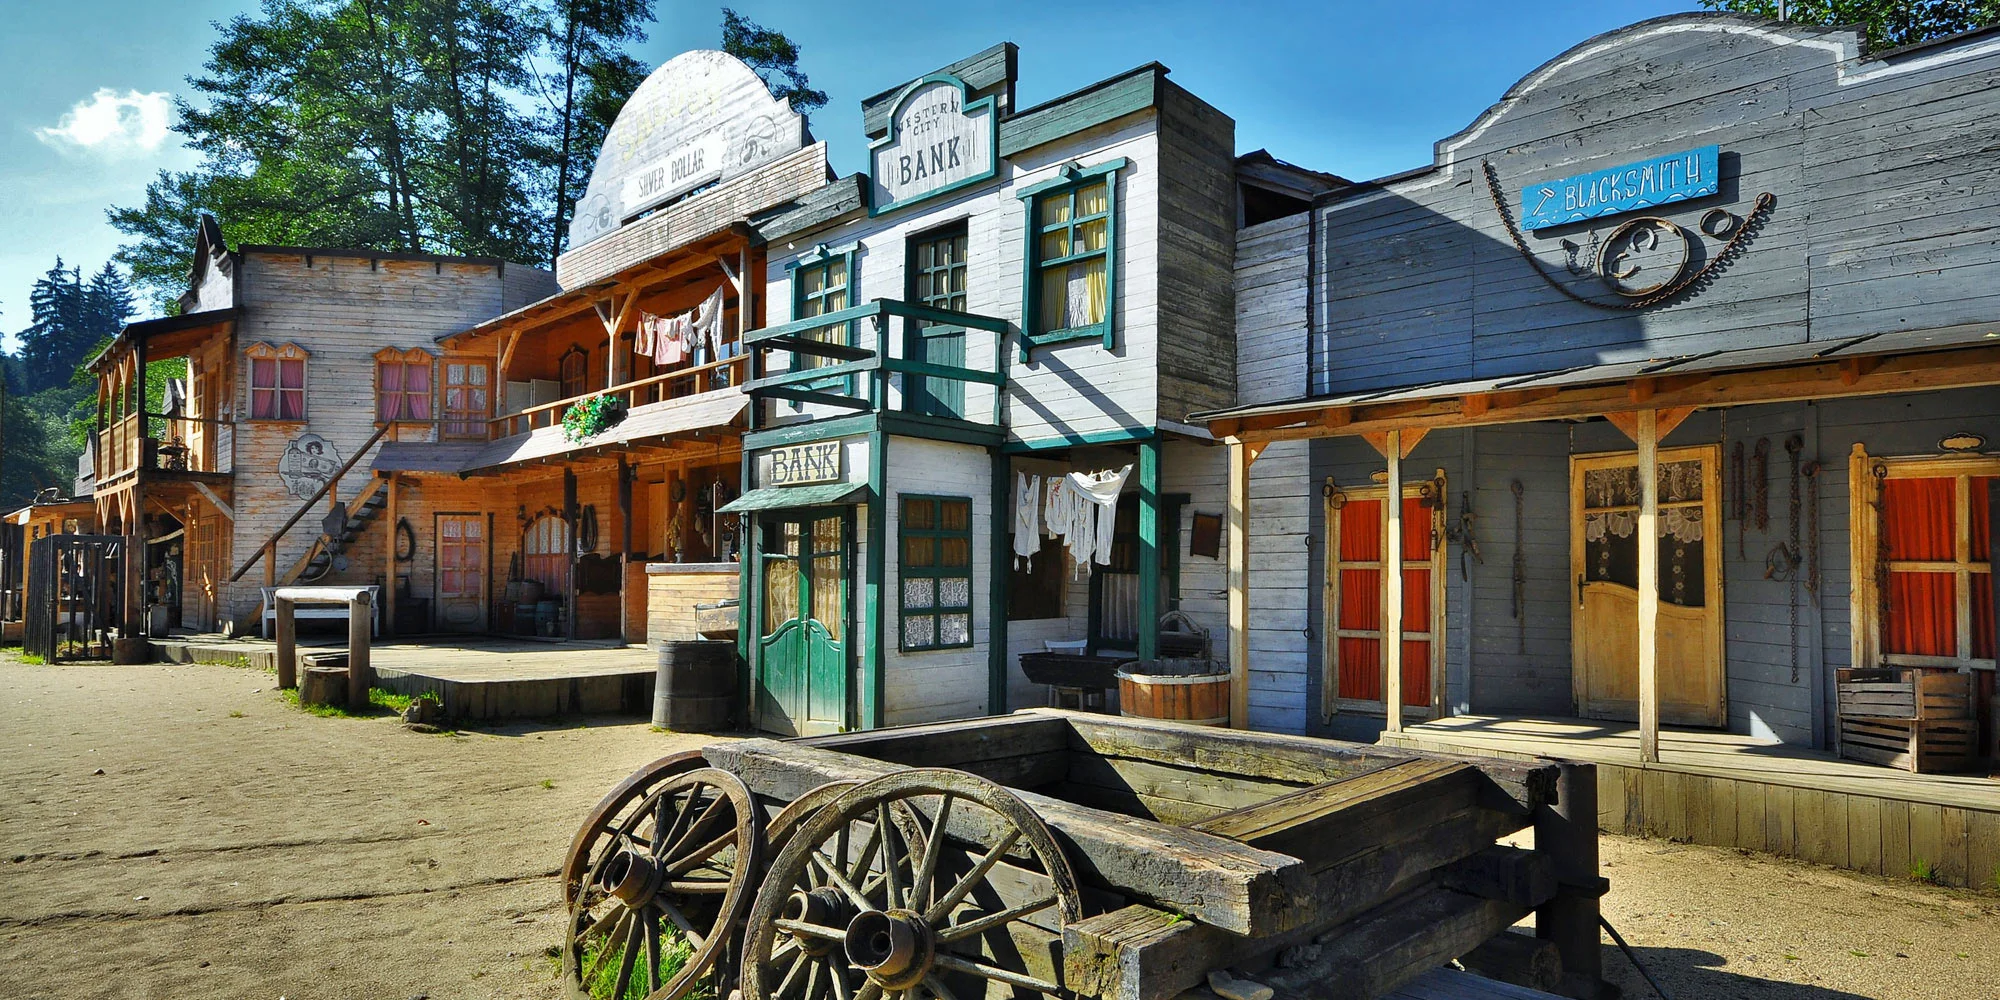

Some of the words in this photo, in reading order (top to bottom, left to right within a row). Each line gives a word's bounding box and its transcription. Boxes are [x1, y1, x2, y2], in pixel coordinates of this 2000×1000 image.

[895, 101, 960, 134] WESTERN
[913, 117, 940, 136] CITY
[638, 167, 664, 198] SILVER
[671, 148, 705, 184] DOLLAR
[899, 136, 961, 186] BANK
[1564, 153, 1702, 211] BLACKSMITH
[771, 443, 838, 483] BANK
